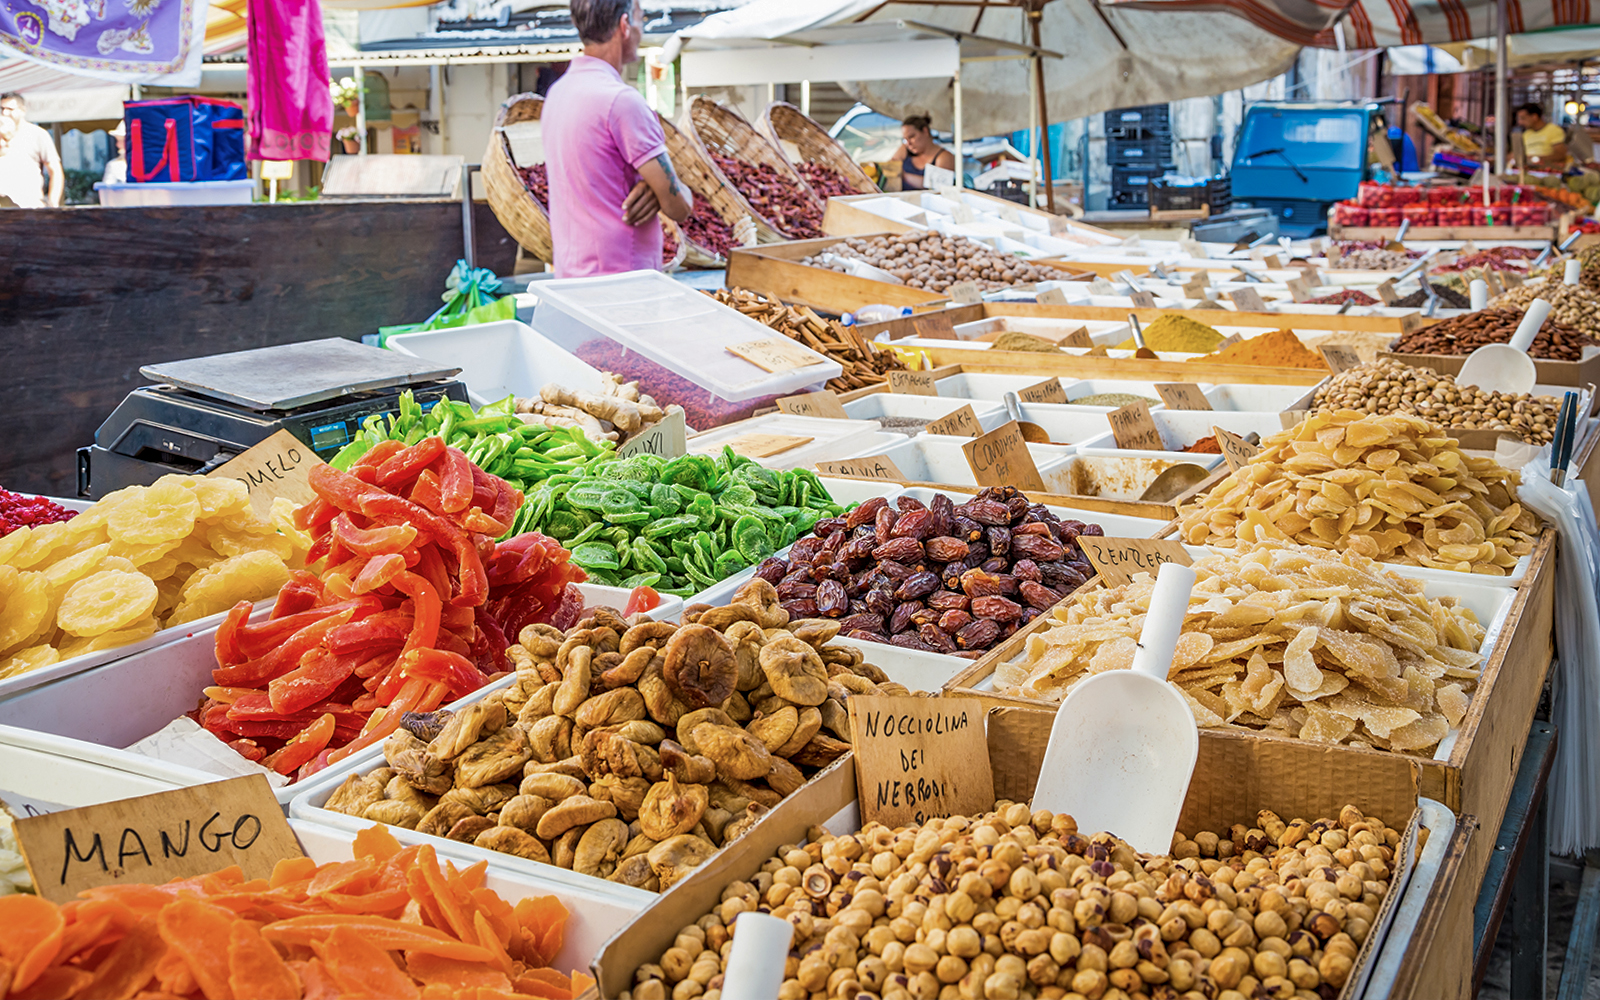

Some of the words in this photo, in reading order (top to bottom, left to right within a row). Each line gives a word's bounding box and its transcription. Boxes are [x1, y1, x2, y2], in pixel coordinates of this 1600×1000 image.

[865, 710, 969, 738] NOCCIOLINA
[900, 748, 924, 773] DEI
[876, 777, 945, 812] NEBRODI
[61, 811, 262, 885] MANGO
